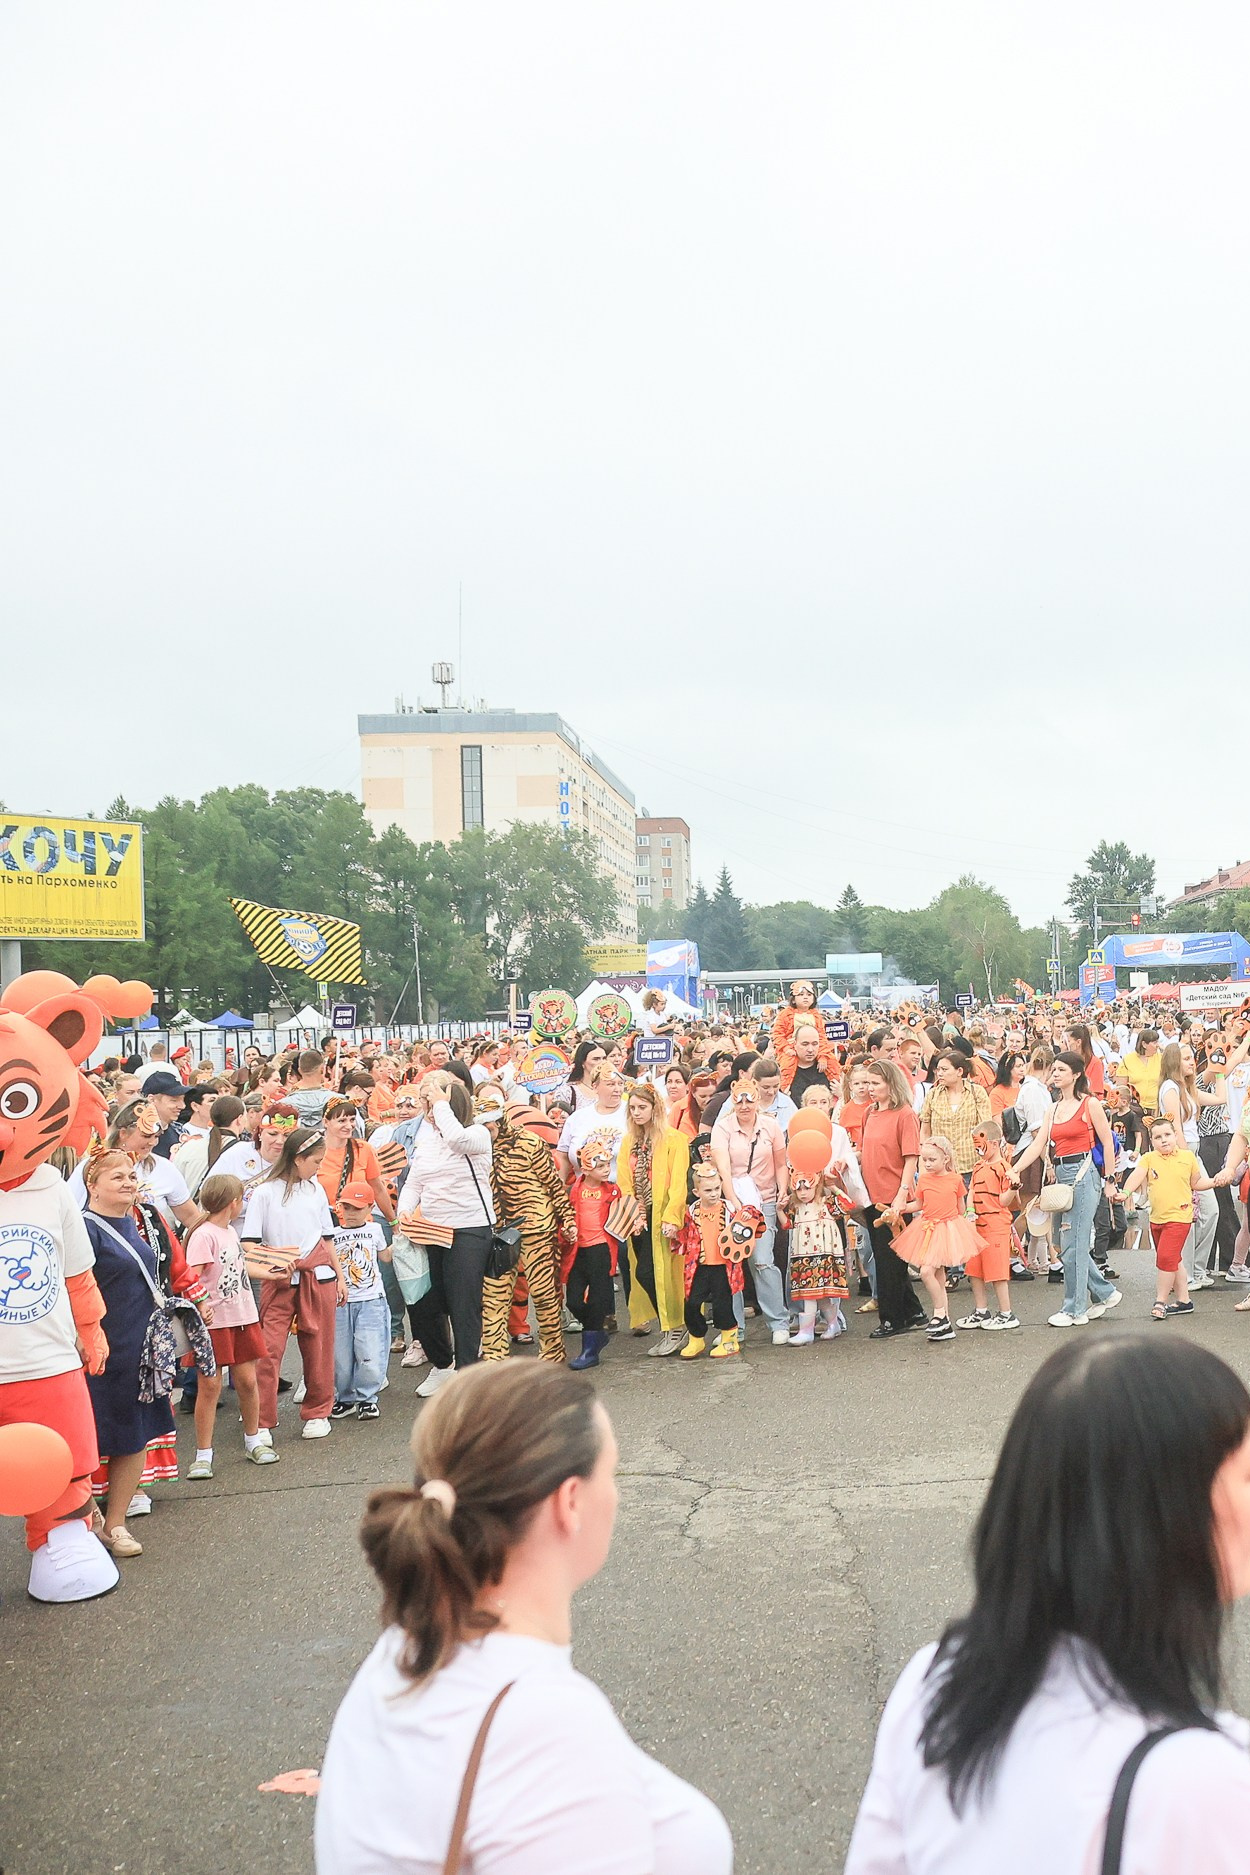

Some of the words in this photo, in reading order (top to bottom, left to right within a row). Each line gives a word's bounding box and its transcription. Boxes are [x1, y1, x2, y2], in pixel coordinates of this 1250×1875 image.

[17, 876, 33, 885] на
[37, 875, 118, 889] Пархоменко
[1203, 985, 1228, 993] МАДОУ
[642, 1042, 666, 1051] ДЕТСКИЙ
[640, 1051, 653, 1060] САД
[334, 1234, 351, 1244] STAY
